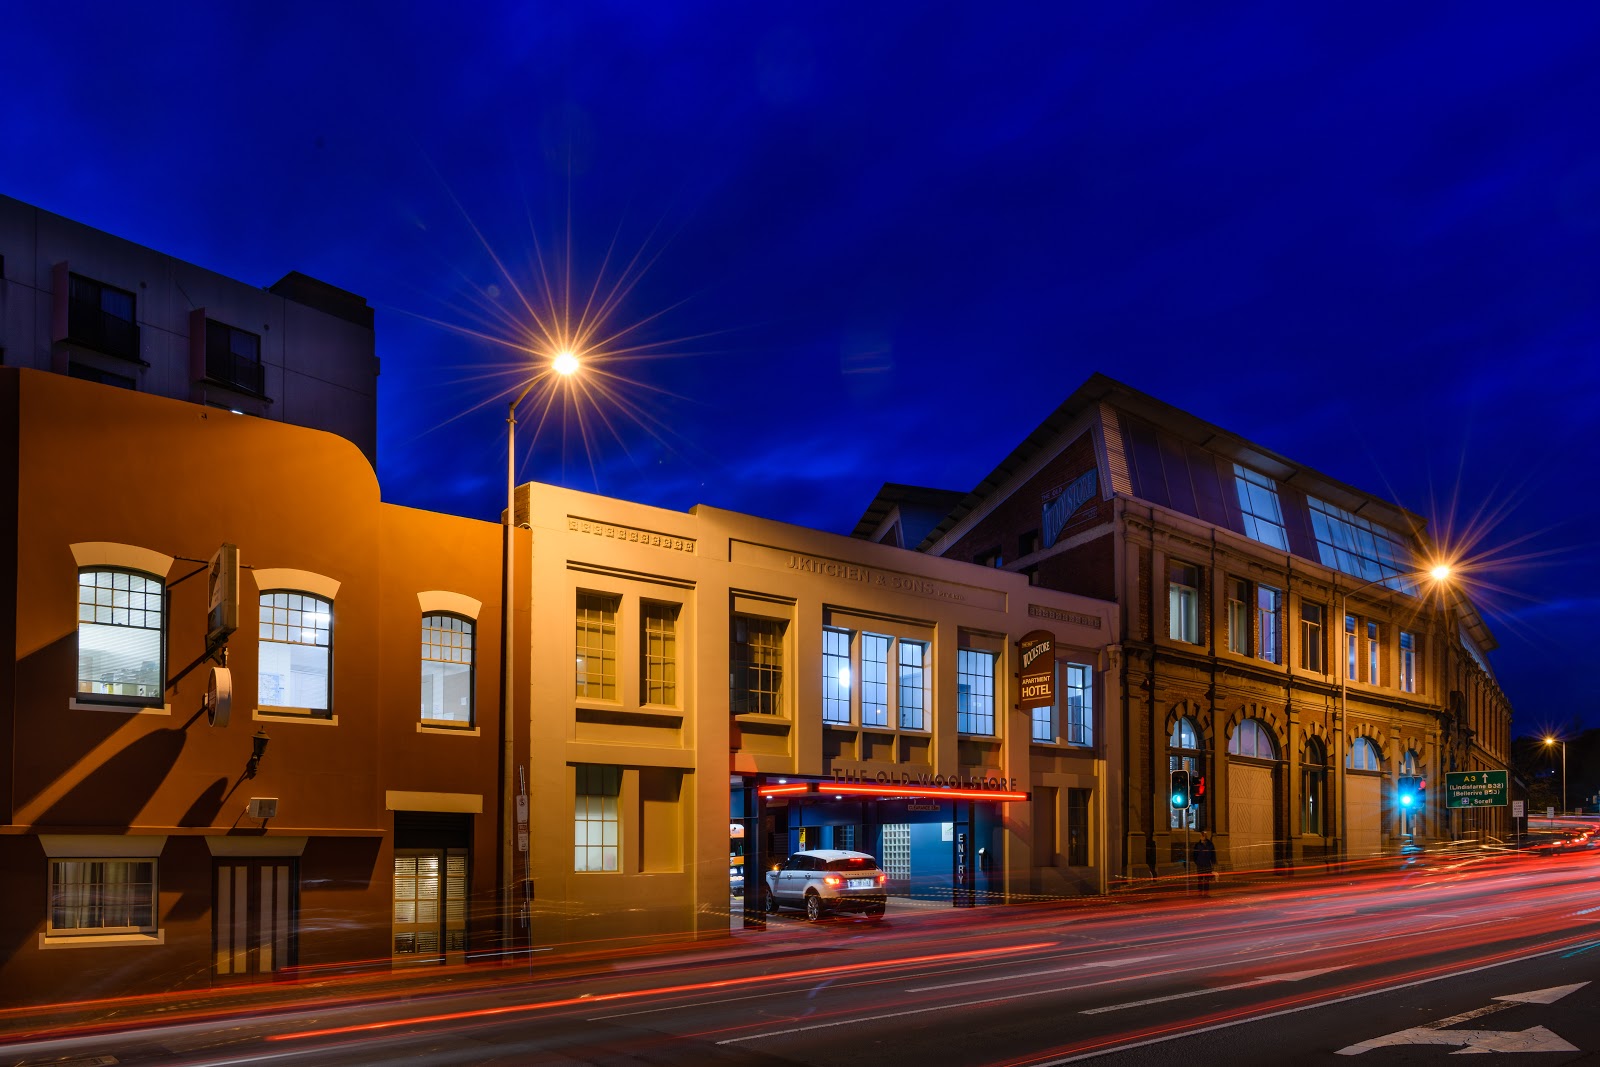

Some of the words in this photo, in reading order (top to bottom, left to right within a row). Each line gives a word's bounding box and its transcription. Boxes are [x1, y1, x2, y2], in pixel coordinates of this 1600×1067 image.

[787, 556, 870, 582] J.KITCHEN
[875, 575, 887, 586] &
[891, 576, 934, 595] SONS
[1023, 642, 1050, 668] WOOLSTORE
[1022, 676, 1050, 684] APARTMENT
[1022, 684, 1051, 697] HOTEL
[833, 767, 867, 785] THE
[875, 770, 910, 786] OLD
[917, 773, 1017, 792] WOOLSTORE
